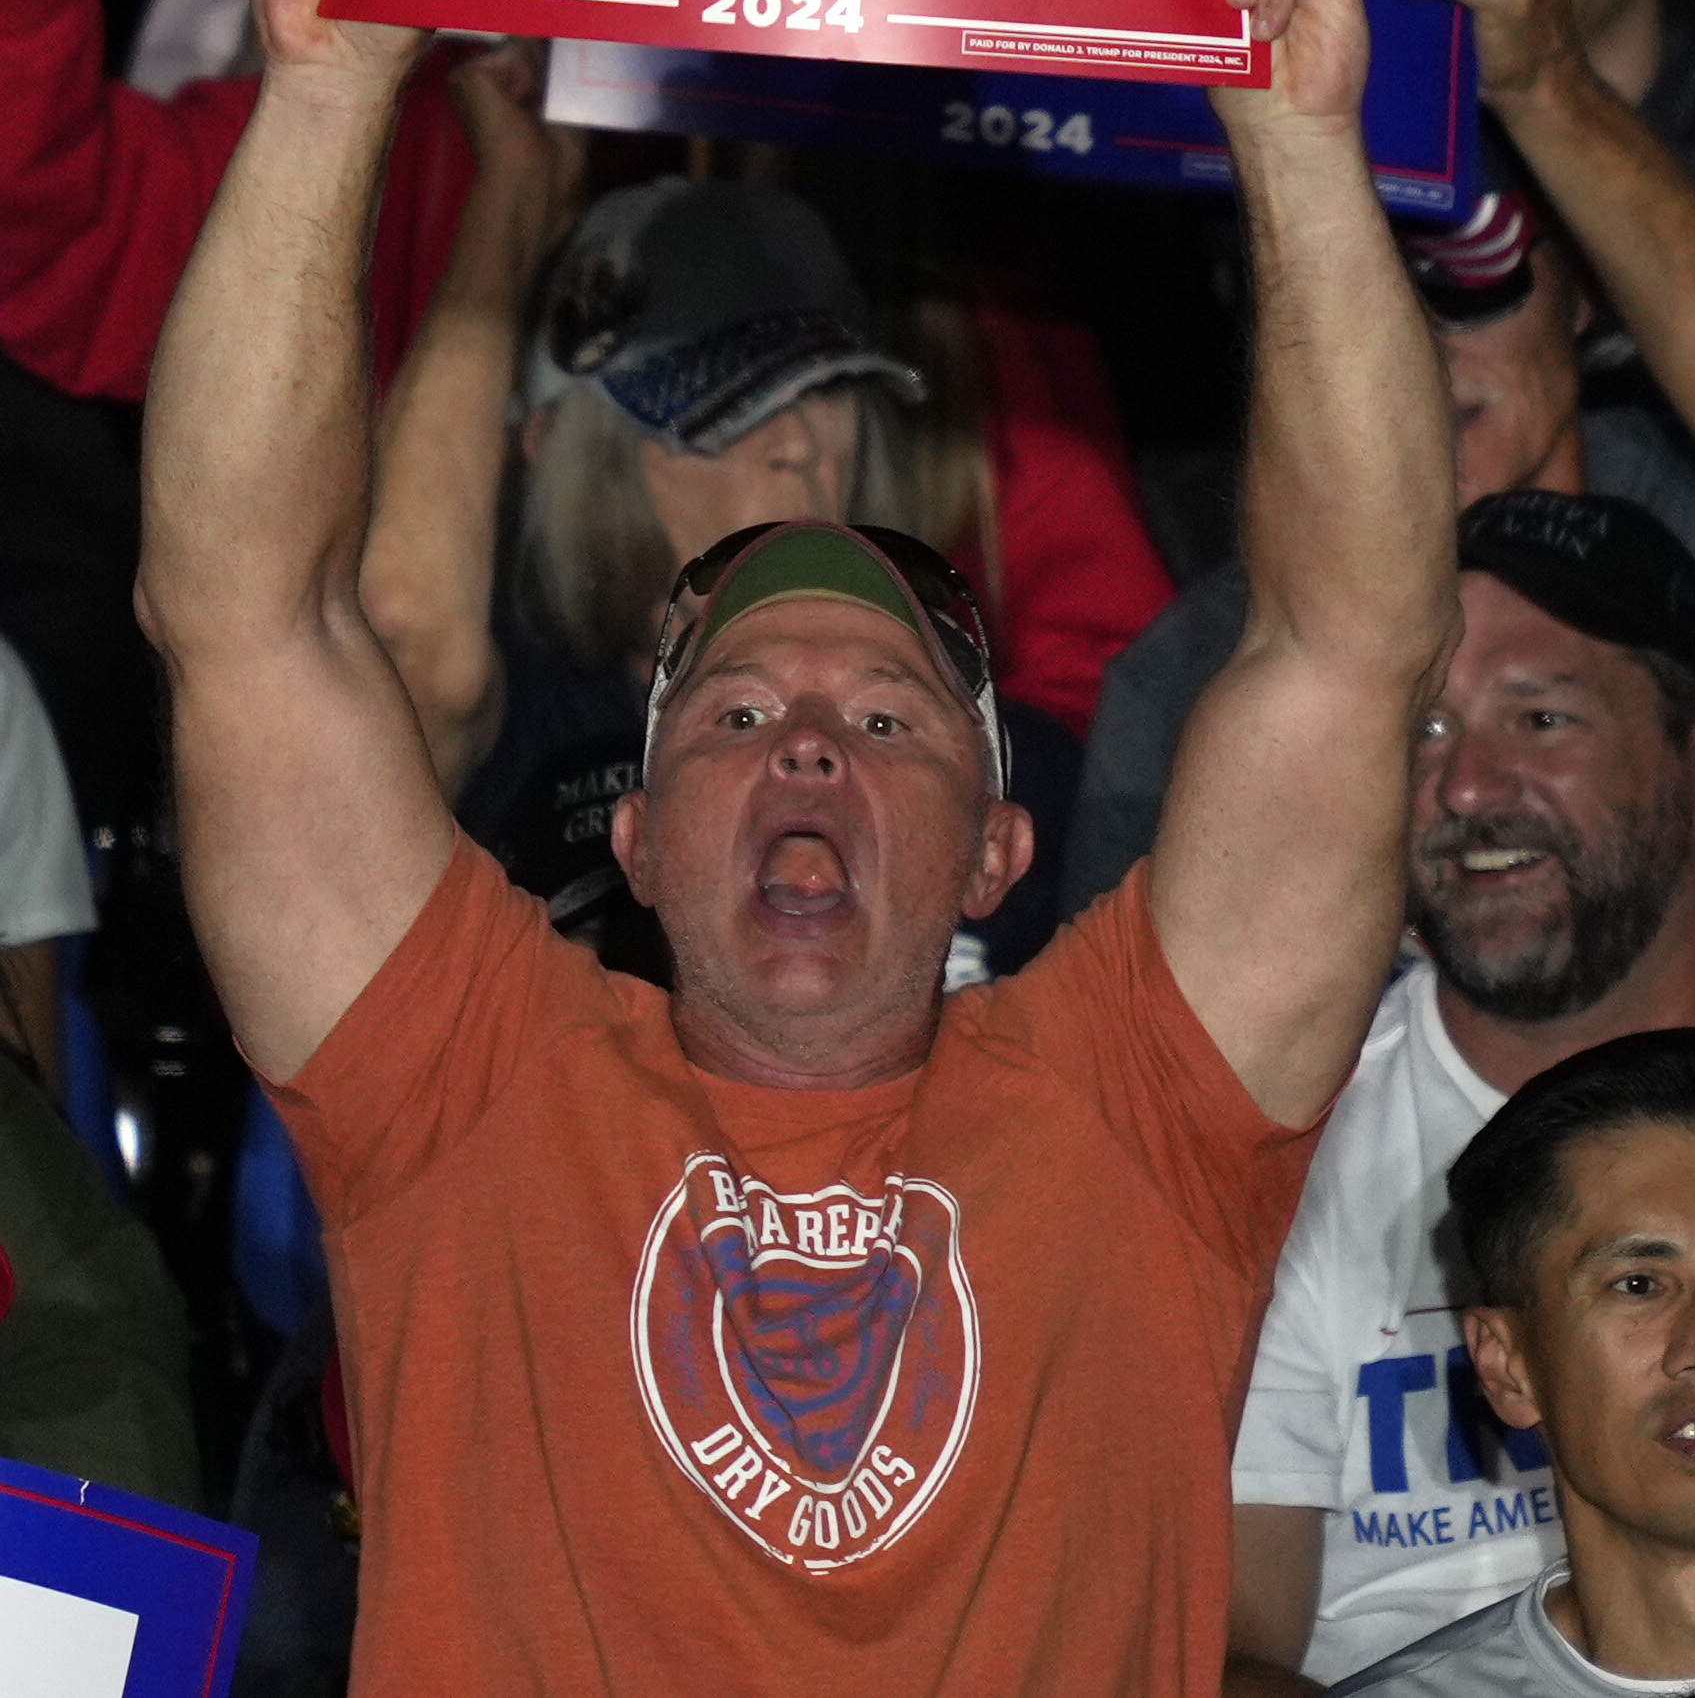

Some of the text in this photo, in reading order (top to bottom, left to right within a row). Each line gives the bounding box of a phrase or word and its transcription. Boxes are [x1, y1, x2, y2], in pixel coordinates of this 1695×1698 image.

[969, 38, 993, 49] PAID
[995, 40, 1016, 50] FOR
[1018, 42, 1031, 52] BY
[1033, 43, 1074, 54] DONALD
[1086, 46, 1120, 57] TRUMP
[1122, 49, 1142, 59] FOR
[1144, 50, 1197, 63] PRESIDENT
[1225, 56, 1244, 66] INC.
[941, 102, 1095, 157] 2024
[691, 1422, 917, 1550] DRY GOODS
[1353, 1507, 1455, 1548] MAKE
